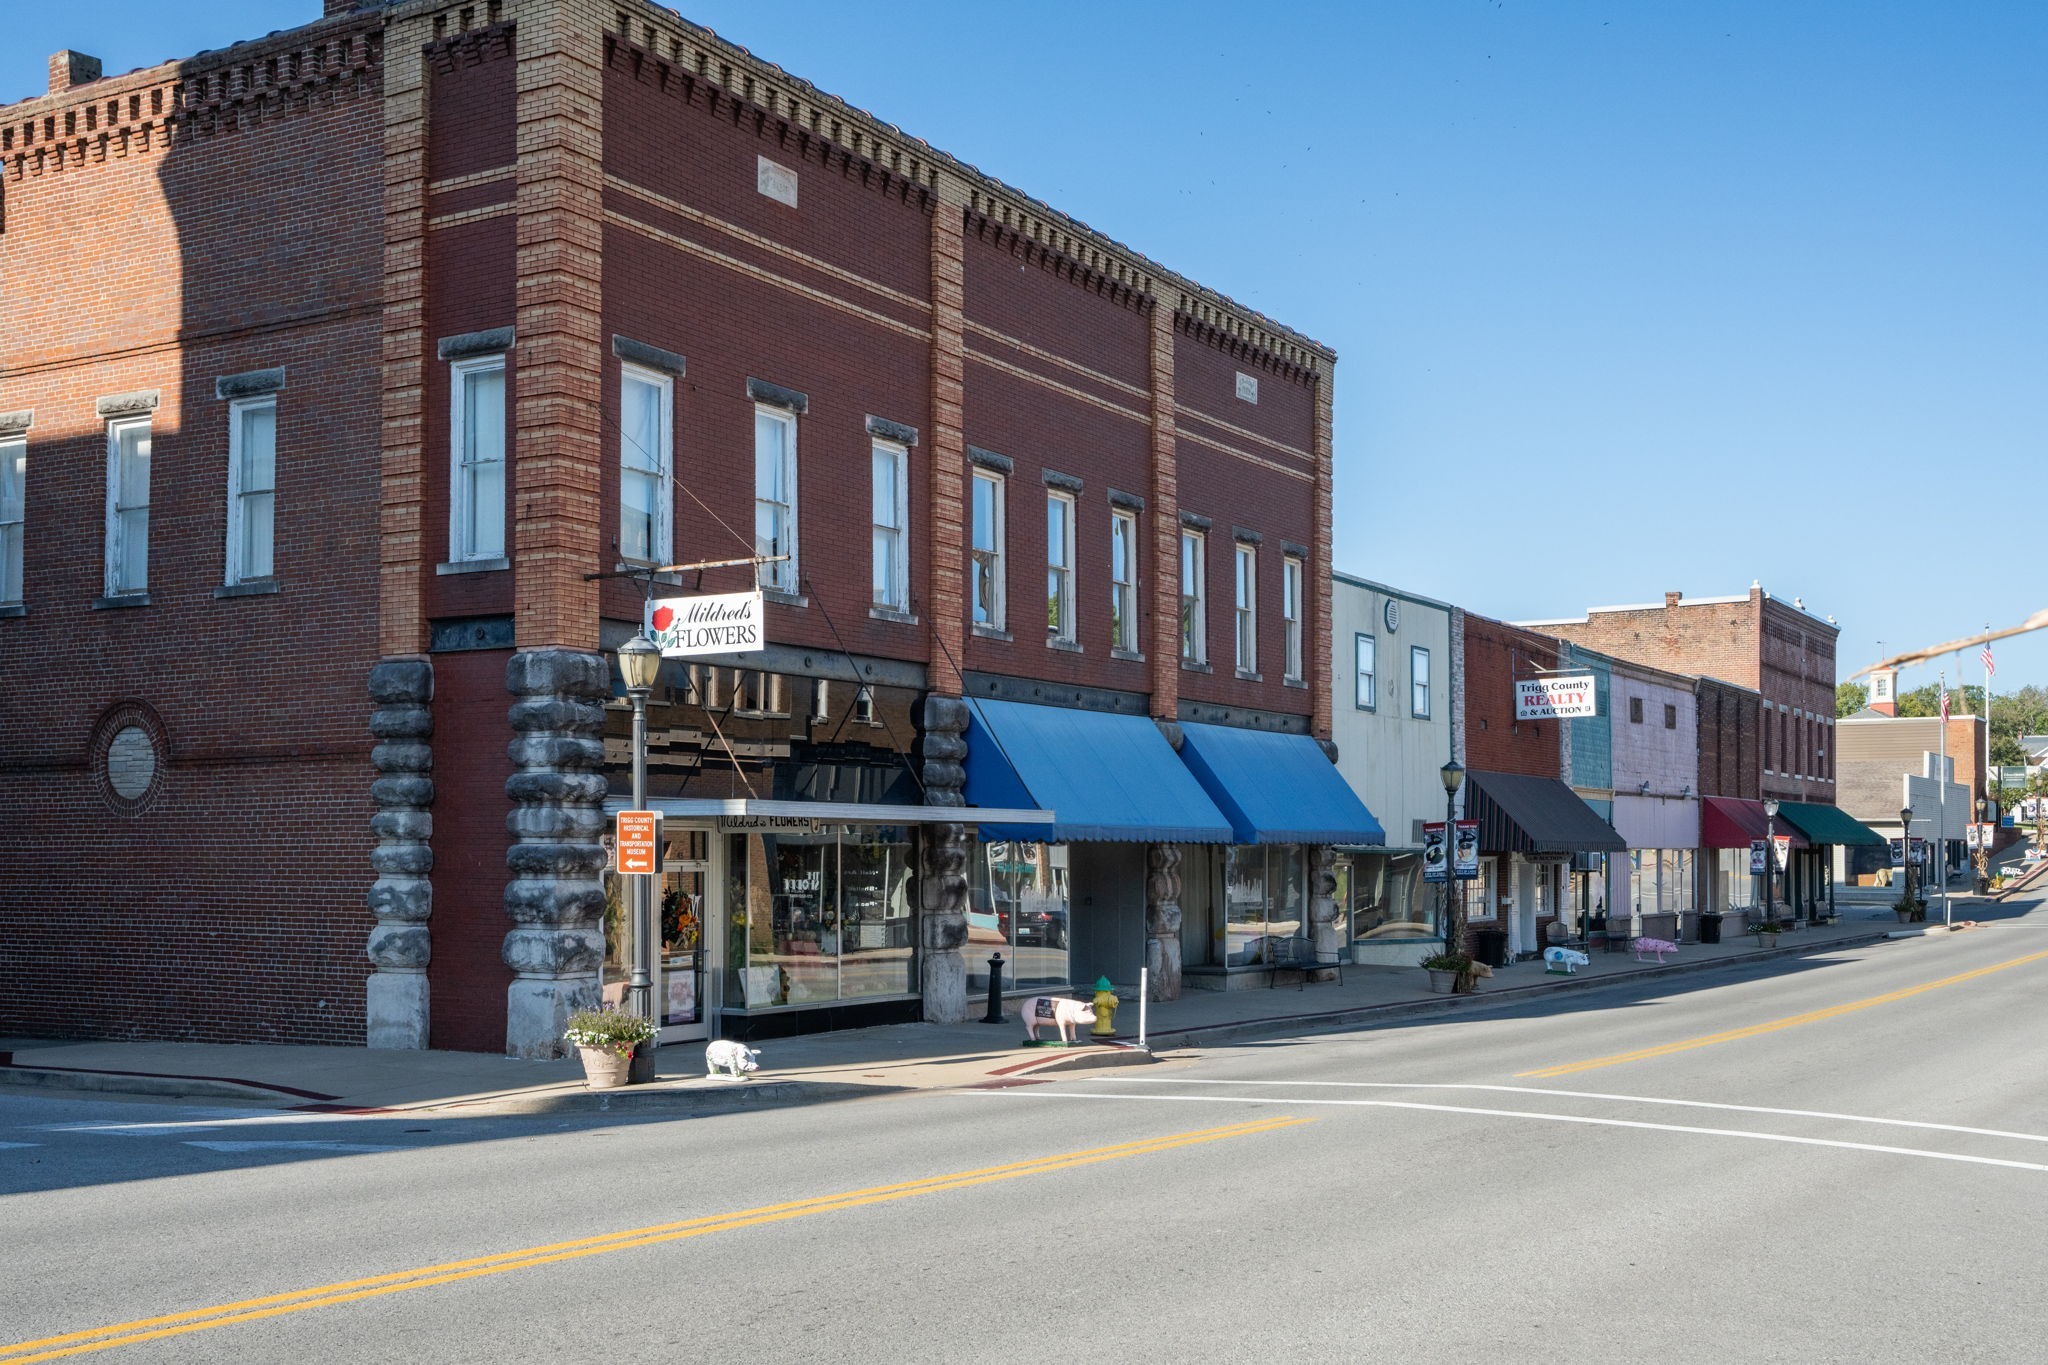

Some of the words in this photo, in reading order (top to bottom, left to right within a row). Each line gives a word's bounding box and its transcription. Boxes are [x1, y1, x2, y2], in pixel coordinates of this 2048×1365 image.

[680, 600, 752, 624] Mildred's
[675, 624, 757, 648] FLOWERS
[1520, 683, 1549, 693] Trigg
[1551, 681, 1590, 690] County
[1523, 692, 1586, 706] REALTY
[1529, 708, 1538, 716] &
[1540, 706, 1582, 716] AUCTION
[720, 815, 767, 828] Mildreds
